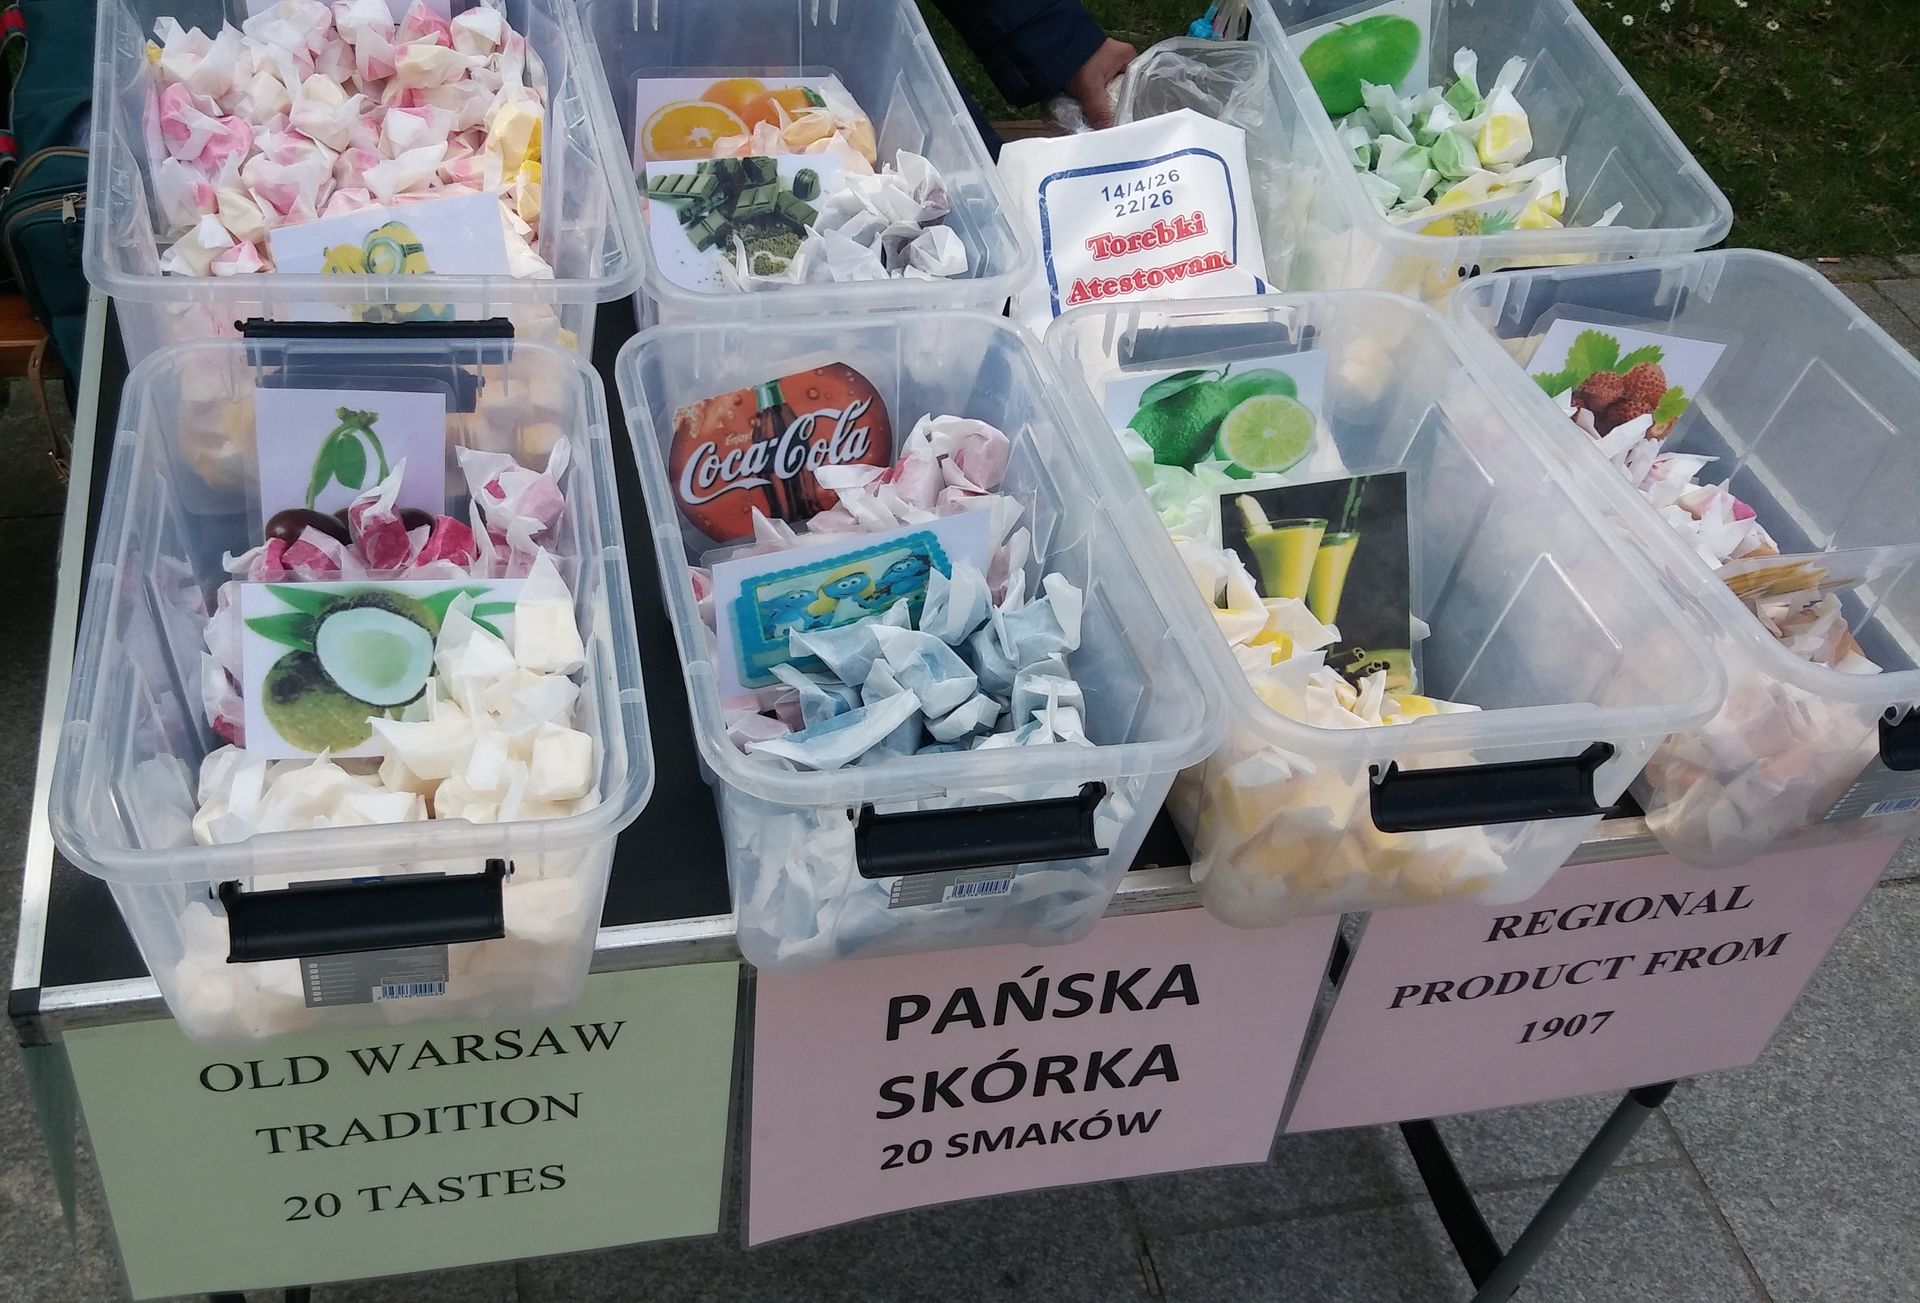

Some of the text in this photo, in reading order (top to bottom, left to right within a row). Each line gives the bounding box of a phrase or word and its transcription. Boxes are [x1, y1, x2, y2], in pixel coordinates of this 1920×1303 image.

[1101, 169, 1181, 202] 14/4/26
[1114, 189, 1174, 218] 22/26
[1085, 211, 1208, 261] Torebki
[679, 395, 873, 505] Coca-Cola
[1483, 884, 1755, 943] REGIONAL
[1386, 932, 1793, 1010] PRODUCT FROM
[885, 964, 1200, 1042] PAŃSKA
[1516, 1010, 1616, 1045] 1907
[199, 1020, 627, 1093] OLD WARSAW
[875, 1043, 1180, 1120] SKÓRKA
[255, 1091, 584, 1155] TRADITION
[880, 1108, 1162, 1170] 20 SMAKÓW
[283, 1163, 567, 1222] 20 TASTES
